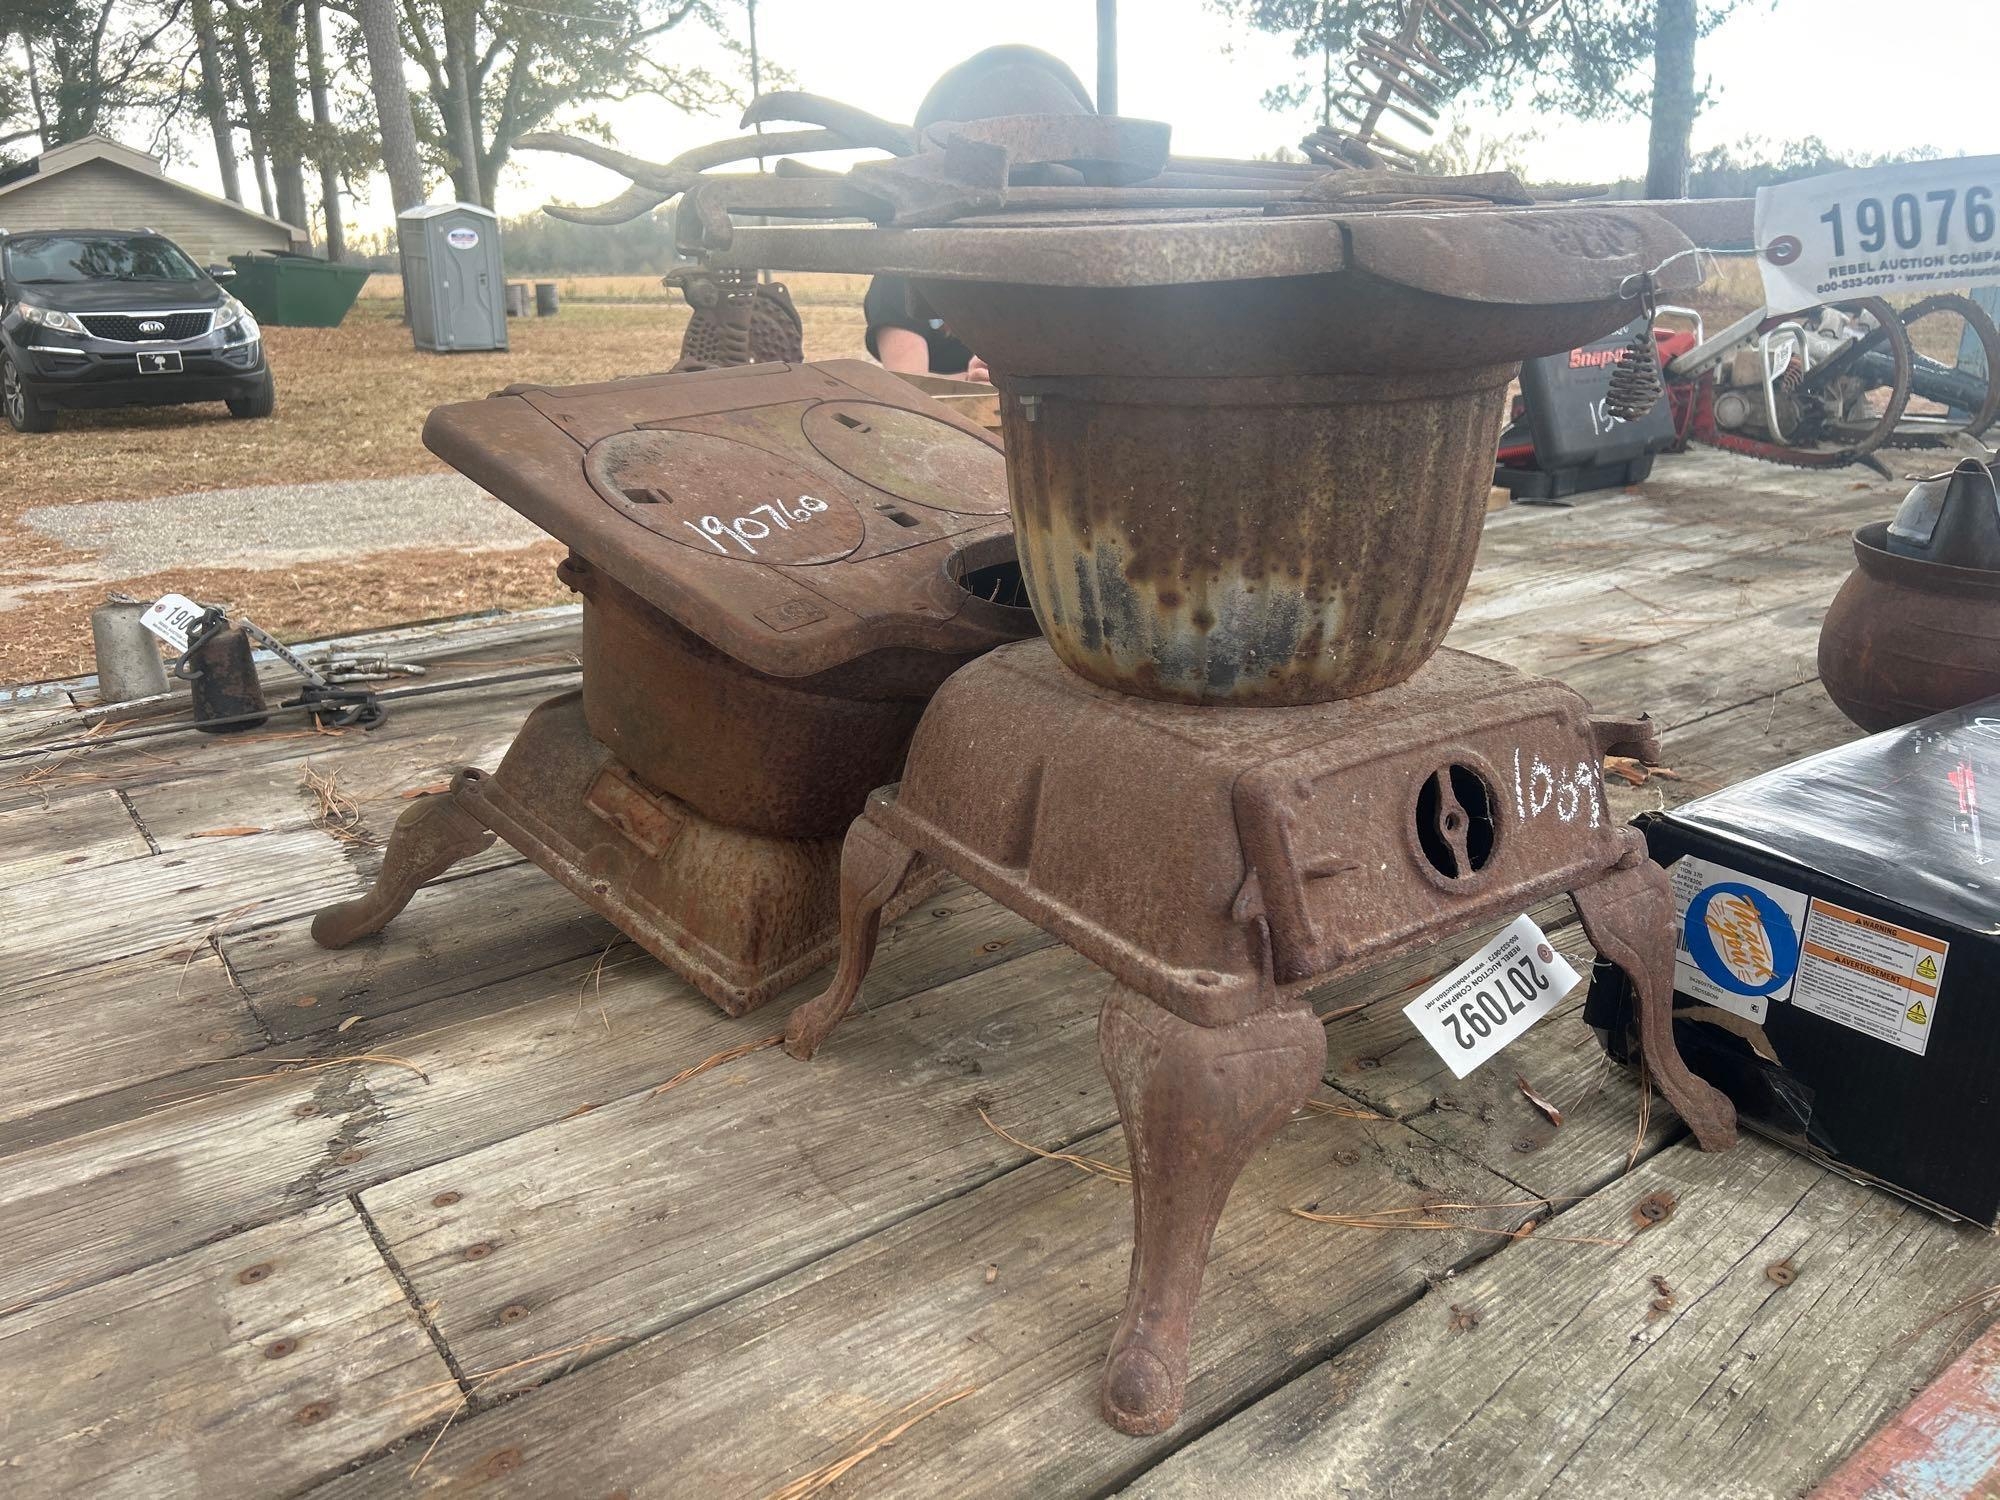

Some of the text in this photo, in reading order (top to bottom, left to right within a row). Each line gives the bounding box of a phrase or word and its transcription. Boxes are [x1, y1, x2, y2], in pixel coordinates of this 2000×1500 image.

[1820, 186, 1998, 257] 19076
[1828, 251, 2000, 279] REBEL AUCTION COMPA
[683, 495, 829, 555] 190760
[165, 606, 195, 631] 190
[1862, 919, 1898, 937] WARNING
[1437, 945, 1521, 1013] REBEL AUCTION COMPANY
[1841, 956, 1901, 984] AVERTISSEMENT
[1442, 954, 1550, 1050] 207092
